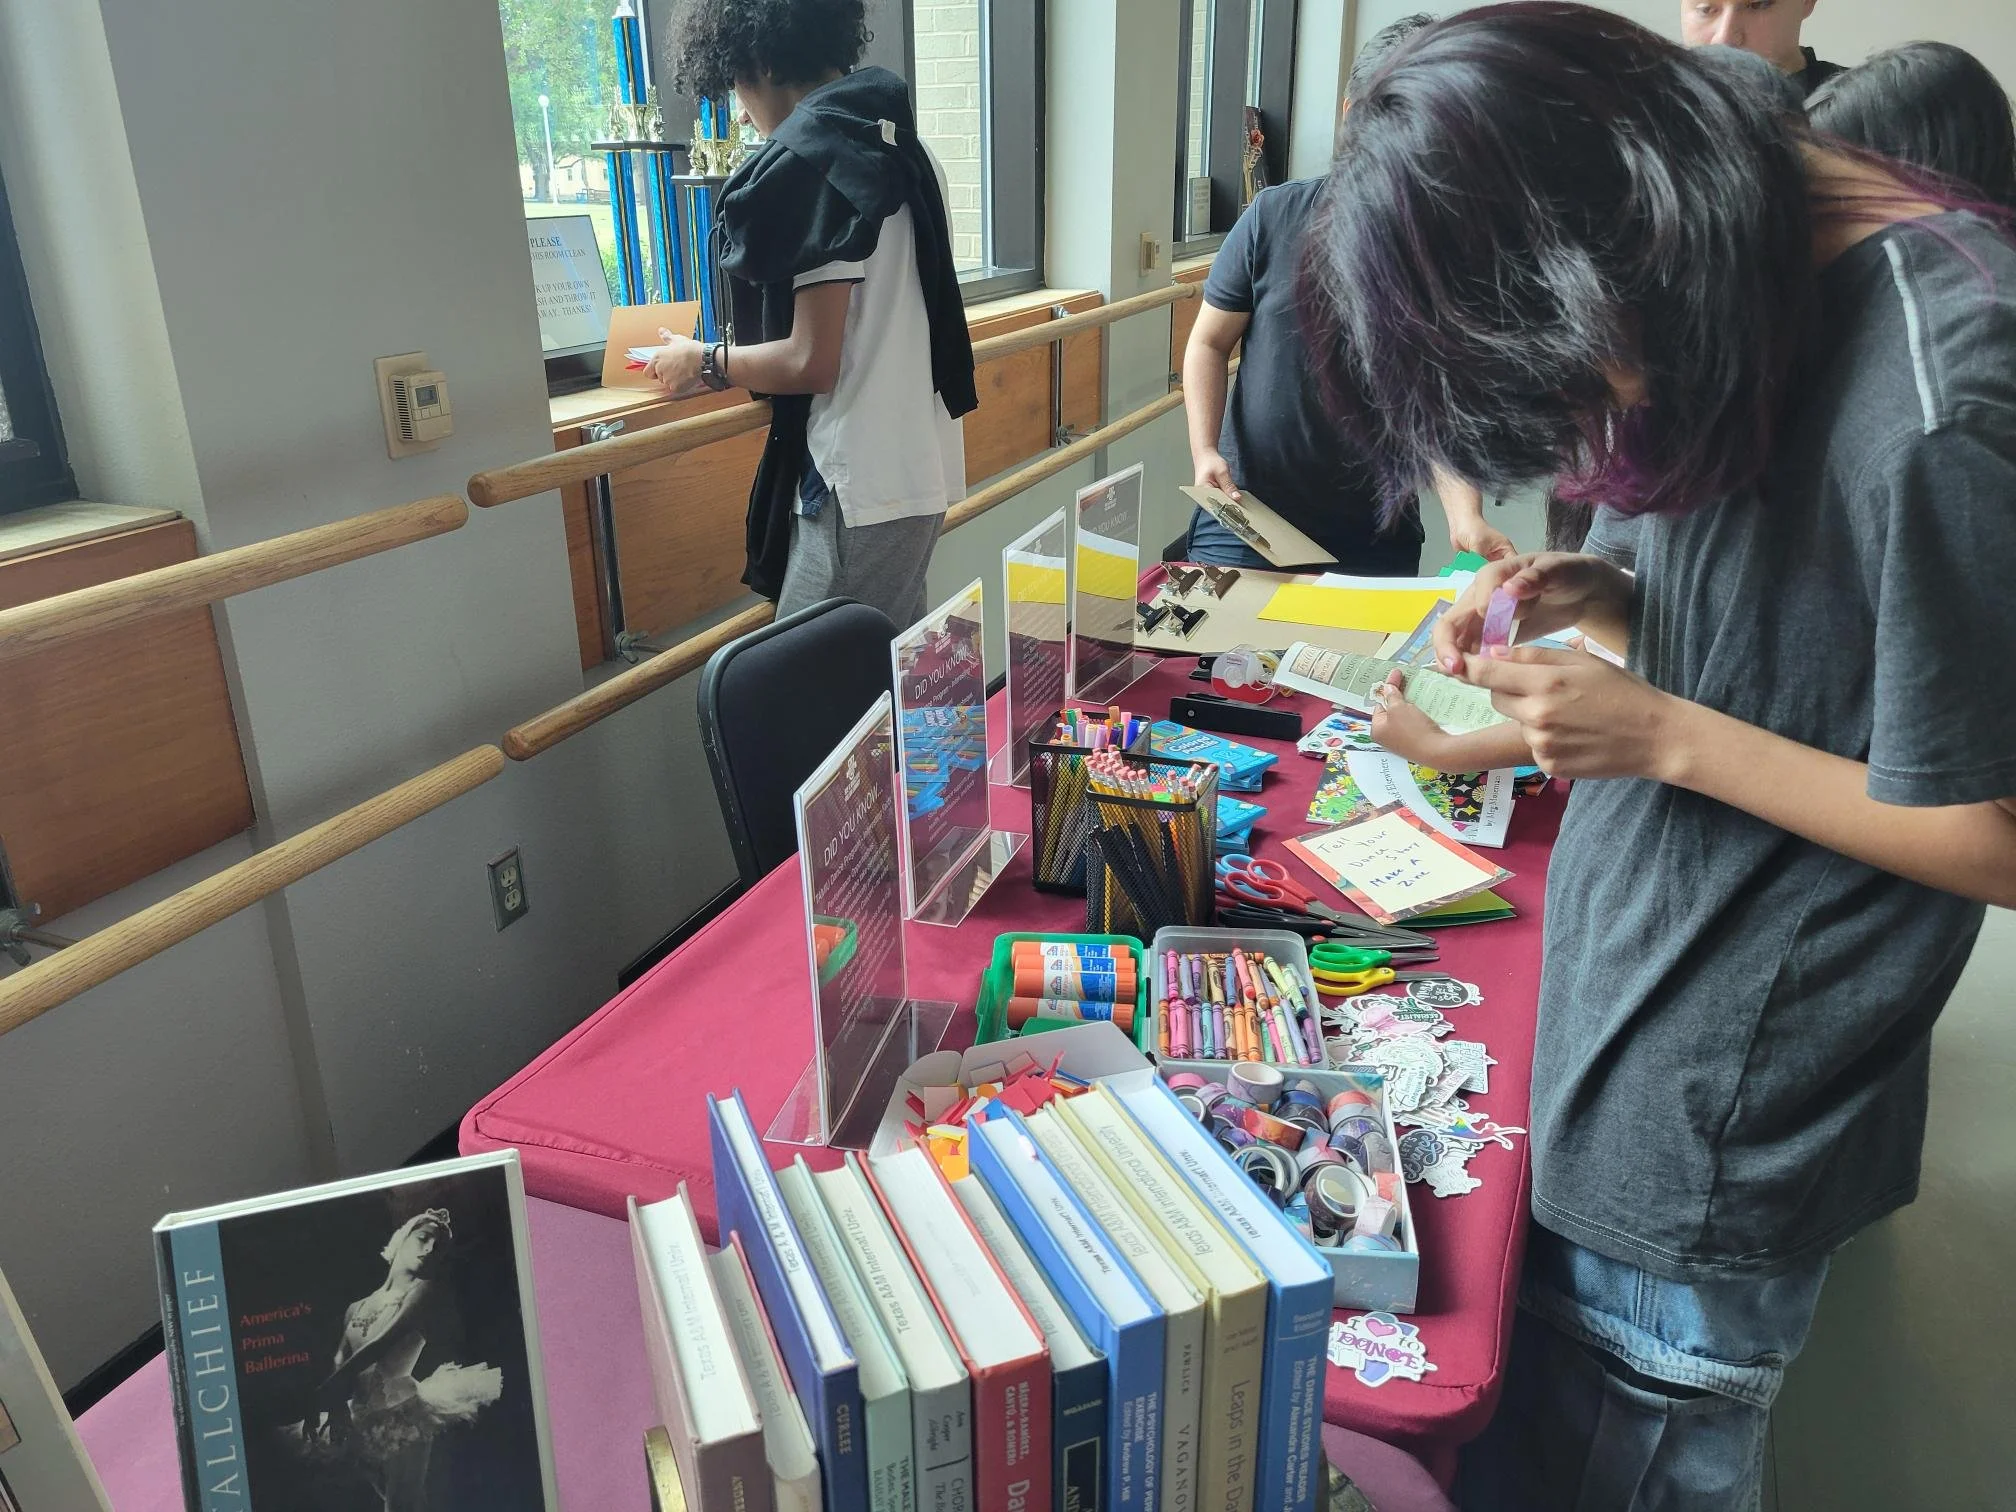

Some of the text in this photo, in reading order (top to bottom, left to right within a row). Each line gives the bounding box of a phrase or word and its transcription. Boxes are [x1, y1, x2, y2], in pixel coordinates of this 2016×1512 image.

[530, 236, 562, 248] PLEASE
[564, 248, 586, 258] CLEAN
[914, 678, 928, 700] DID
[928, 663, 944, 687] YOU
[1168, 736, 1211, 752] Colored
[1380, 758, 1398, 794] Elsewhere
[824, 837, 838, 866] DID
[839, 813, 856, 844] YOU
[1317, 830, 1388, 854] Tell Your
[1348, 842, 1420, 868] Dance Story
[1410, 858, 1421, 866] A
[1396, 871, 1430, 887] Zine
[1399, 1012, 1439, 1022] AERIALIST
[1164, 1208, 1193, 1230] A&M
[1236, 1216, 1262, 1239] Texas
[851, 1230, 881, 1274] Internat'l
[1185, 1228, 1214, 1256] Texas
[784, 1245, 800, 1273] Texas
[1093, 1254, 1112, 1275] Texas
[872, 1274, 894, 1300] A&M
[240, 1303, 313, 1328] America's
[890, 1300, 911, 1334] Texas
[242, 1332, 286, 1352] Prima
[1348, 1319, 1420, 1351] I to
[244, 1352, 310, 1375] Ballerina
[697, 1344, 717, 1381] Texas
[1337, 1332, 1420, 1370] DANCE
[1293, 1360, 1304, 1390] Edited
[184, 1270, 243, 1512] ALLCHIEF
[1147, 1392, 1157, 1413] THE
[1227, 1380, 1250, 1430] Leaps
[1290, 1392, 1302, 1404] by
[942, 1414, 953, 1442] Cooper
[1123, 1401, 1132, 1427] Edited
[1134, 1396, 1146, 1443] EXERCISE
[1145, 1413, 1156, 1474] PSYCHOLOGY
[1228, 1434, 1242, 1450] in
[1288, 1406, 1300, 1454] Alexandra
[1296, 1356, 1318, 1504] THE DANCE STUDIES READER
[1006, 1430, 1017, 1466] ROMERO
[1122, 1442, 1132, 1474] Andrew
[1144, 1476, 1154, 1489] OF
[1226, 1456, 1247, 1484] the
[1285, 1454, 1298, 1486] Carter
[936, 1482, 946, 1500] The
